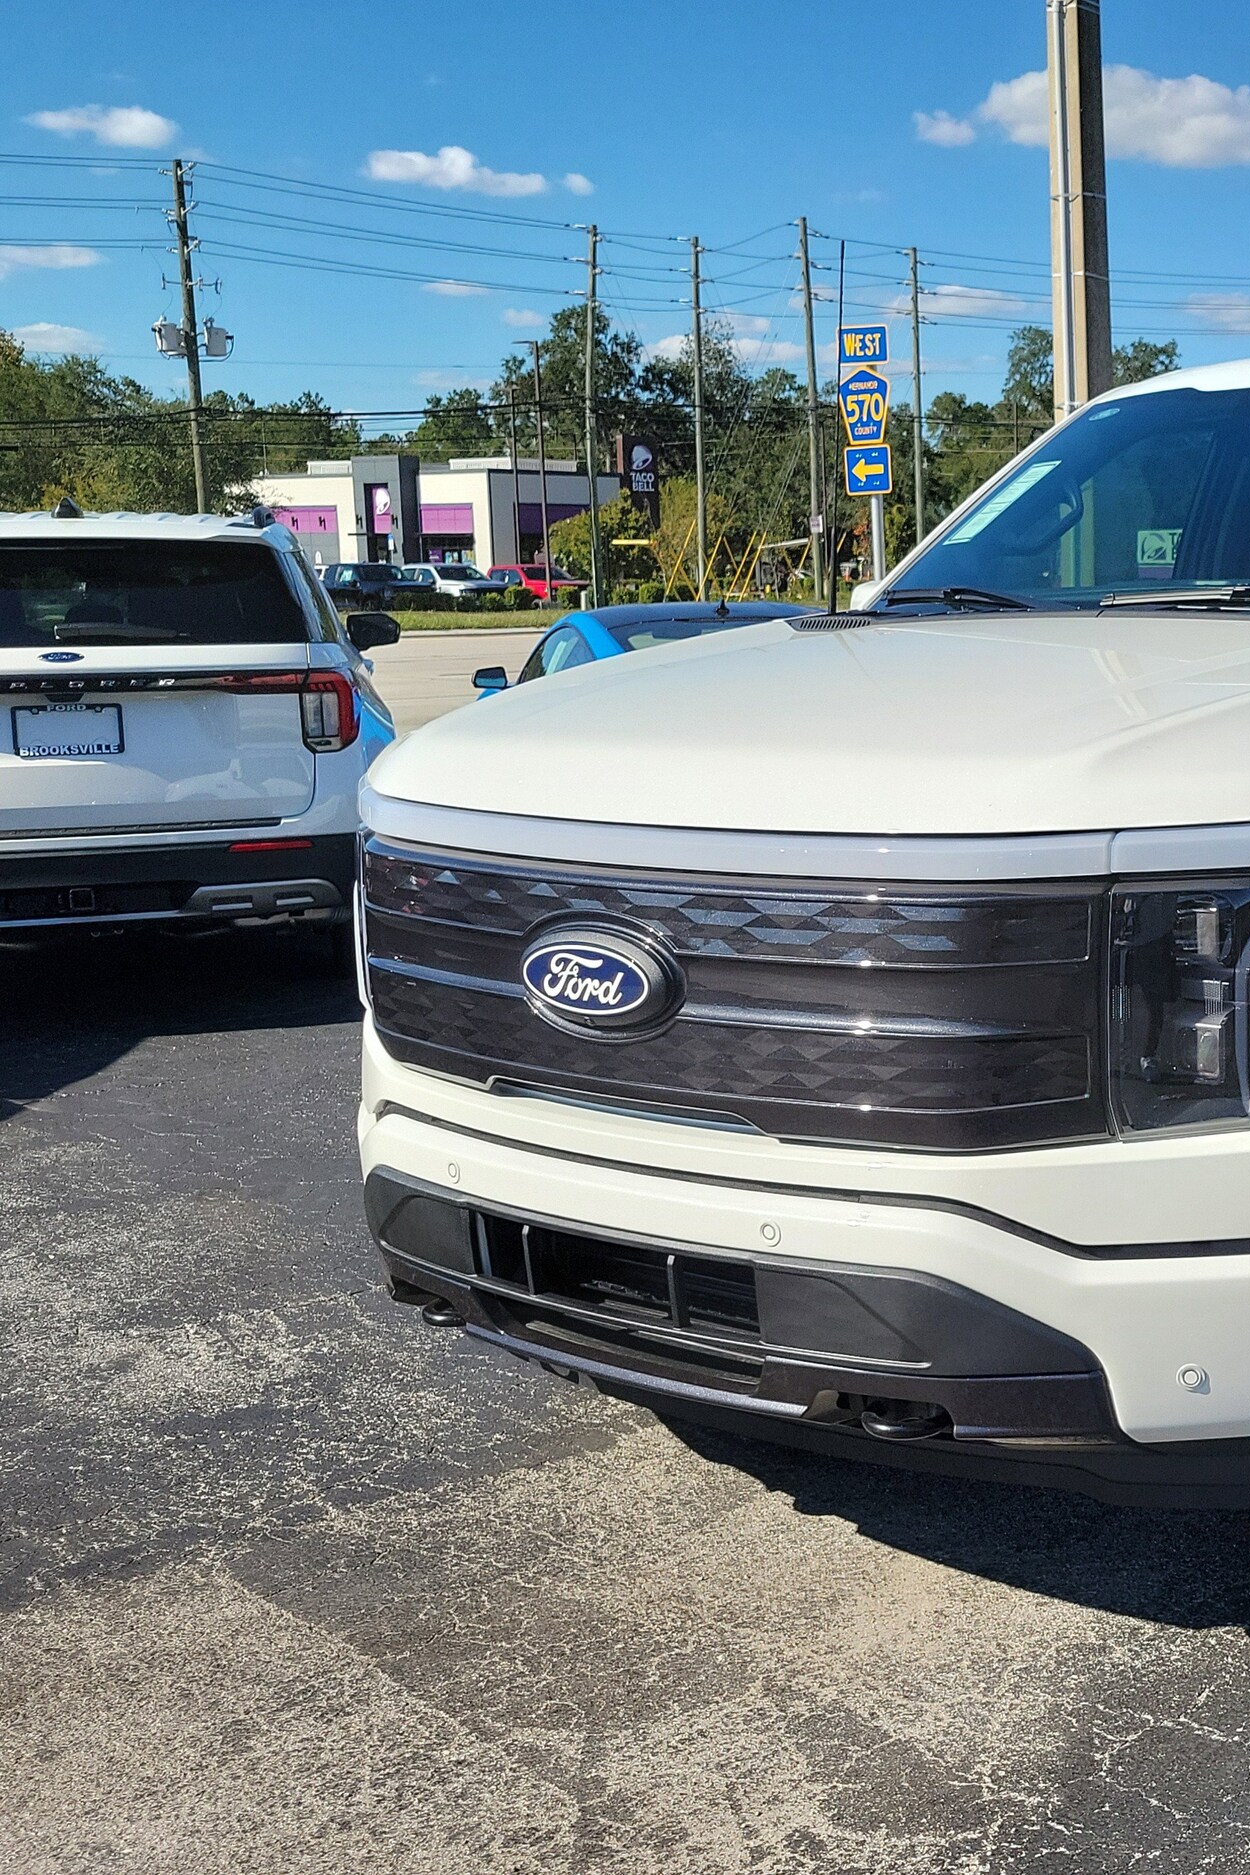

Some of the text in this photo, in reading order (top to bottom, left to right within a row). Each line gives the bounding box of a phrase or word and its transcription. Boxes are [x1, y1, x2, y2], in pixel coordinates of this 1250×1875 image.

[843, 332, 882, 357] WEST
[846, 392, 884, 424] 570
[629, 471, 655, 482] TACO
[632, 481, 655, 492] BELL
[46, 704, 87, 713] FORD
[19, 743, 120, 758] BROOKSVILLE
[543, 952, 625, 1006] Ford
